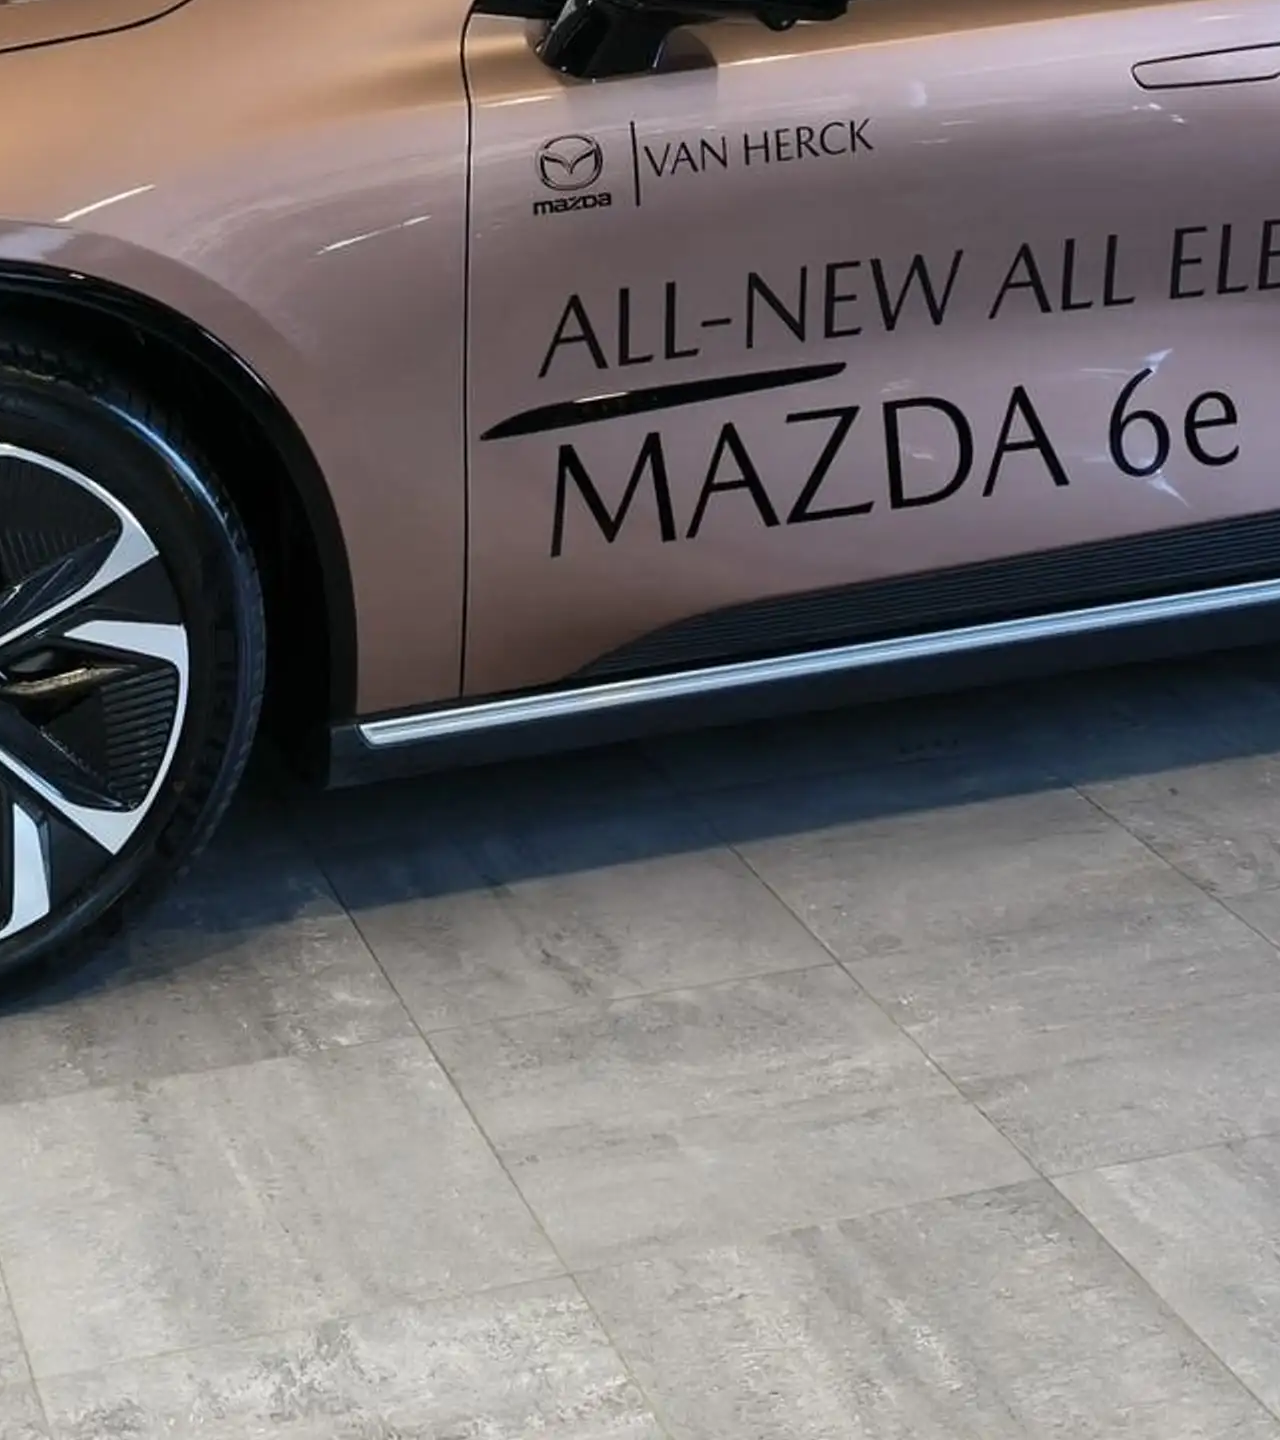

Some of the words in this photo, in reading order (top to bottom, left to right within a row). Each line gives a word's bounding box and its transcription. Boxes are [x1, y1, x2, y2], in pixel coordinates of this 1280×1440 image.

[644, 135, 729, 178] VAN
[742, 117, 875, 166] HERCK
[532, 191, 613, 217] mazda
[538, 247, 965, 379] ALL-NEW
[988, 234, 1137, 321] ALL
[548, 383, 1070, 559] MAZDA
[1107, 366, 1241, 479] 6e
